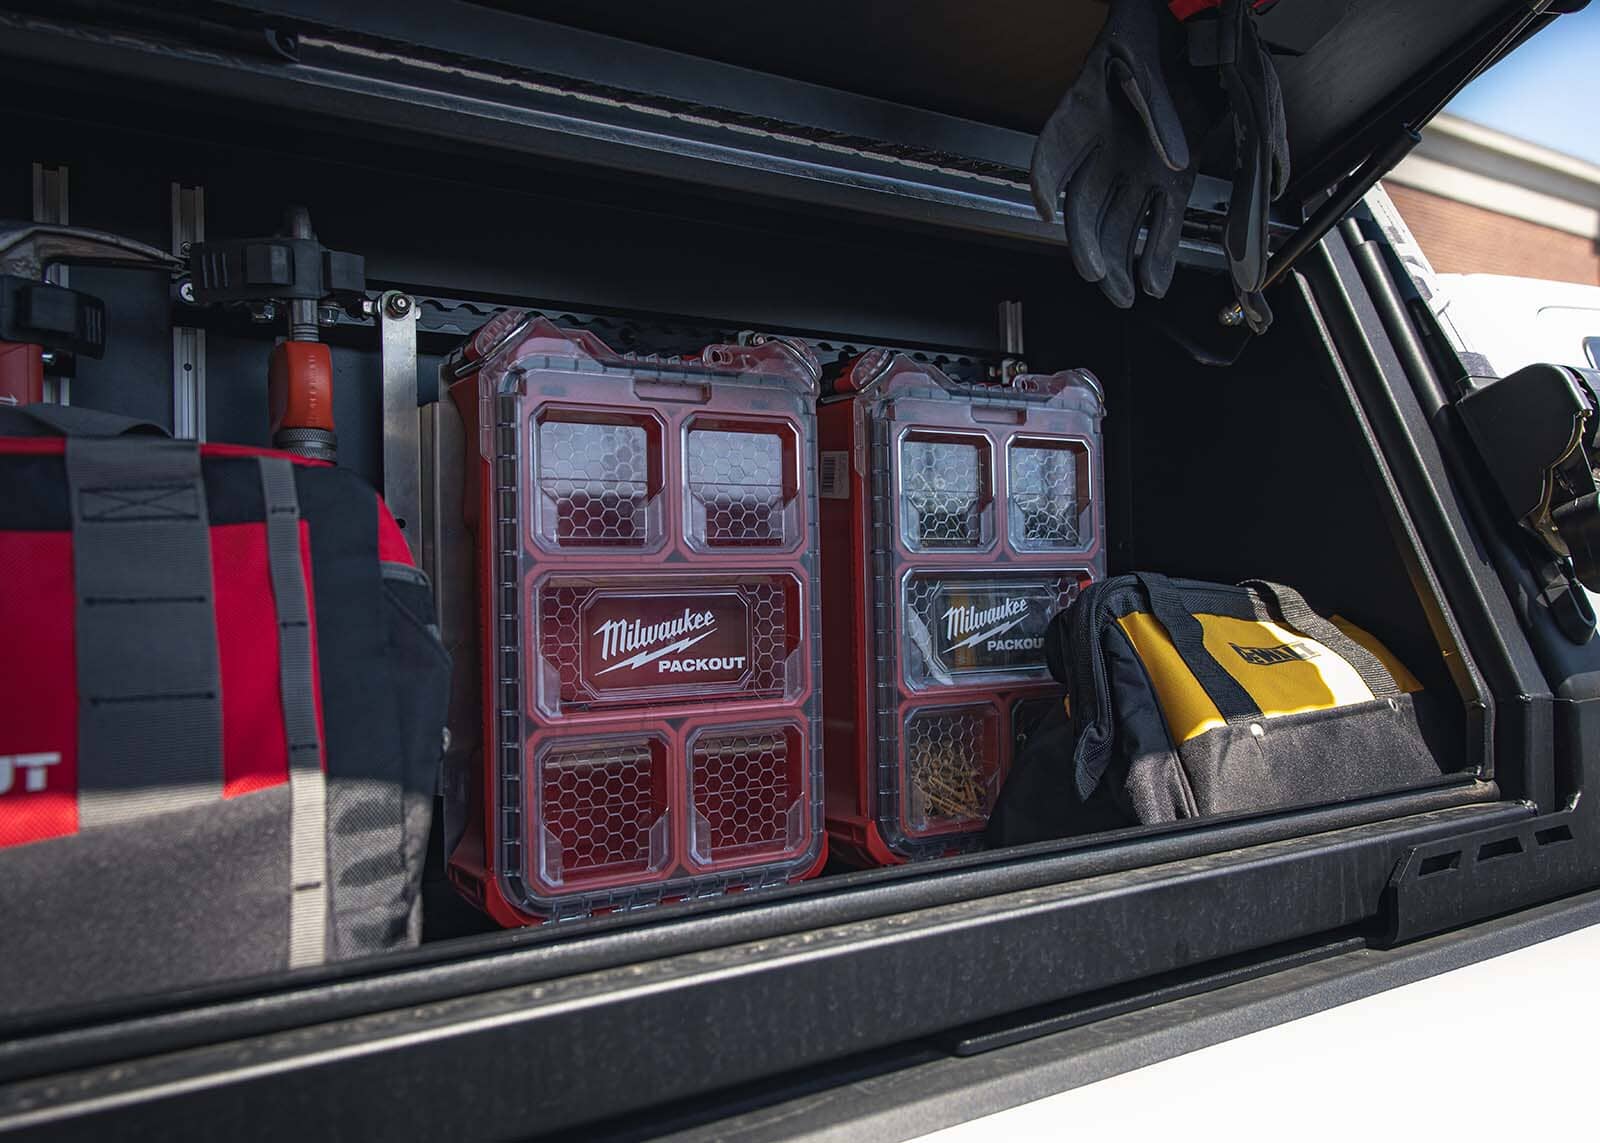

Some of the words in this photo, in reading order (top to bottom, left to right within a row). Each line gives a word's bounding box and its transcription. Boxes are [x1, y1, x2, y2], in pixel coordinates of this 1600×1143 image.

[593, 608, 716, 661] Milwaukee
[941, 598, 1029, 641] Milwaukee
[987, 636, 1044, 651] PACKOU
[658, 656, 746, 673] PACKOUT
